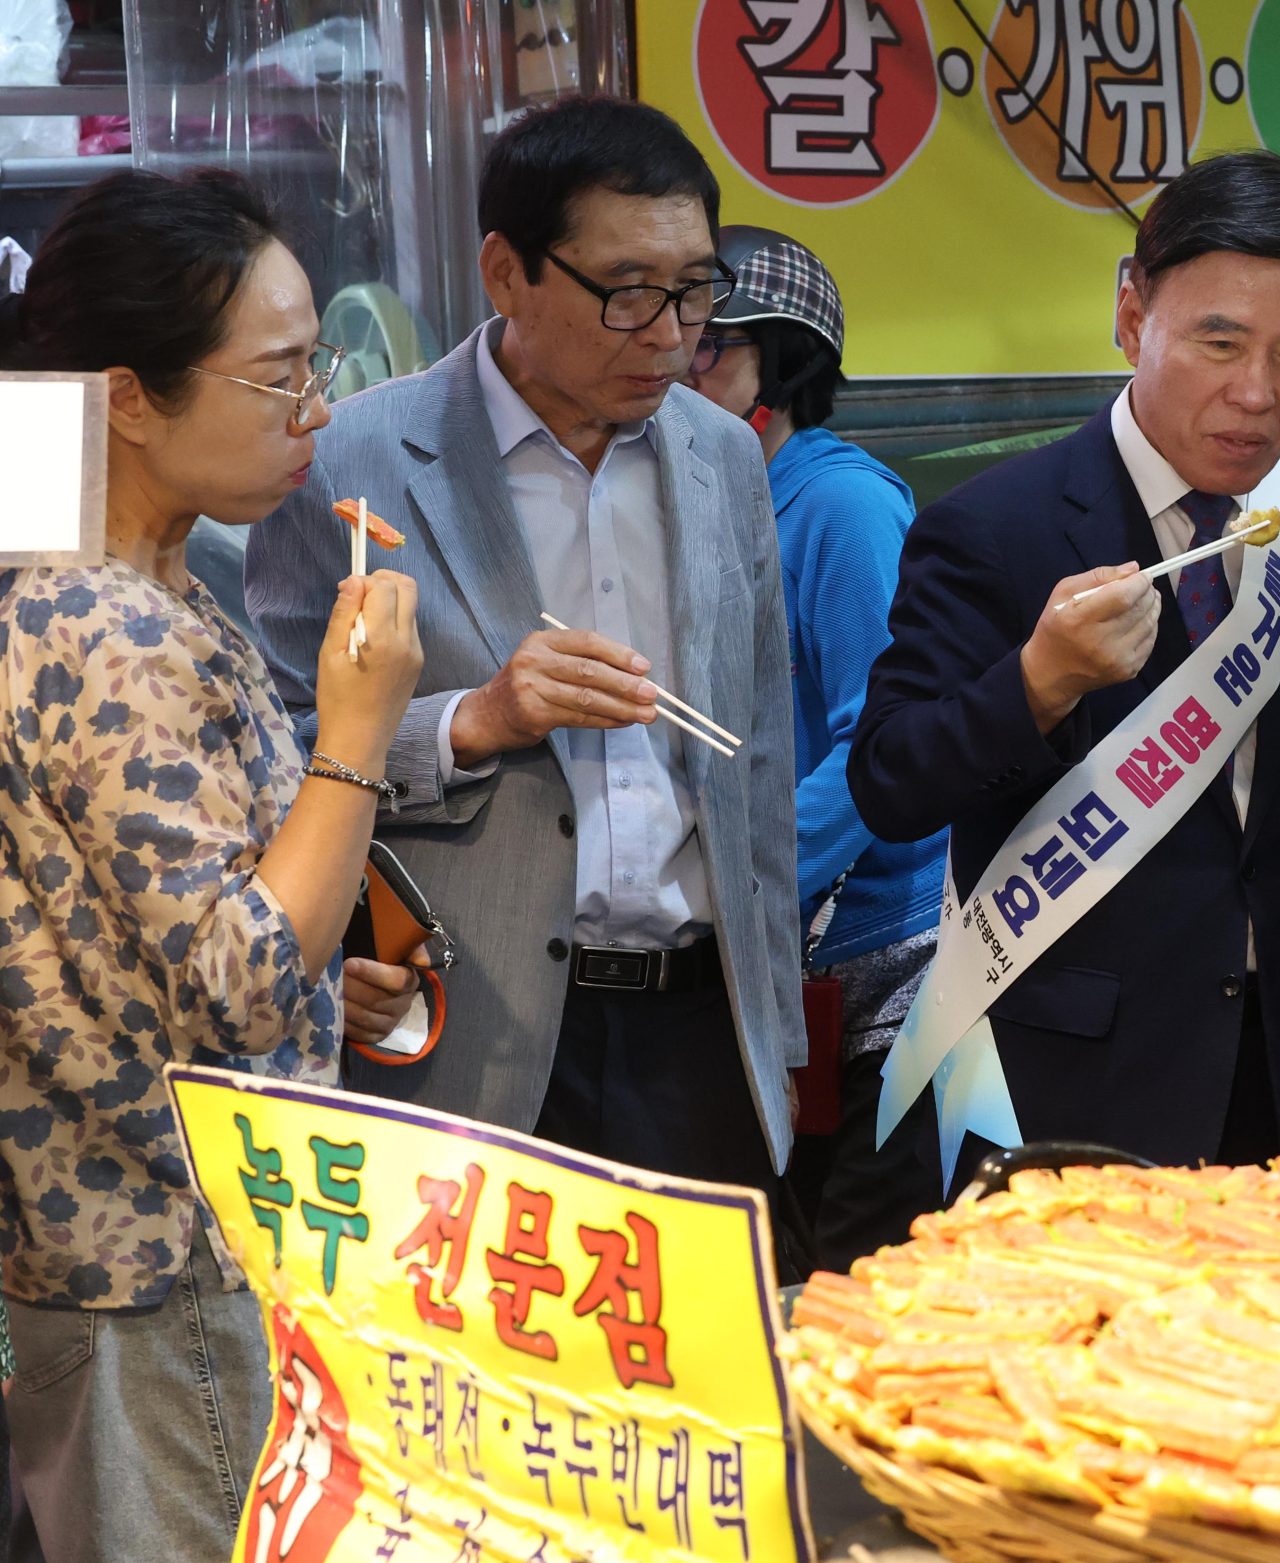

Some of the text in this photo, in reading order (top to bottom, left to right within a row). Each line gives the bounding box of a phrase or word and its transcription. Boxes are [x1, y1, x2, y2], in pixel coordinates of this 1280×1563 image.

[1115, 695, 1222, 808] 명절
[992, 791, 1129, 938] 되세요
[973, 897, 1013, 974] 대전광역시
[233, 1113, 674, 1389] 녹두 전문점
